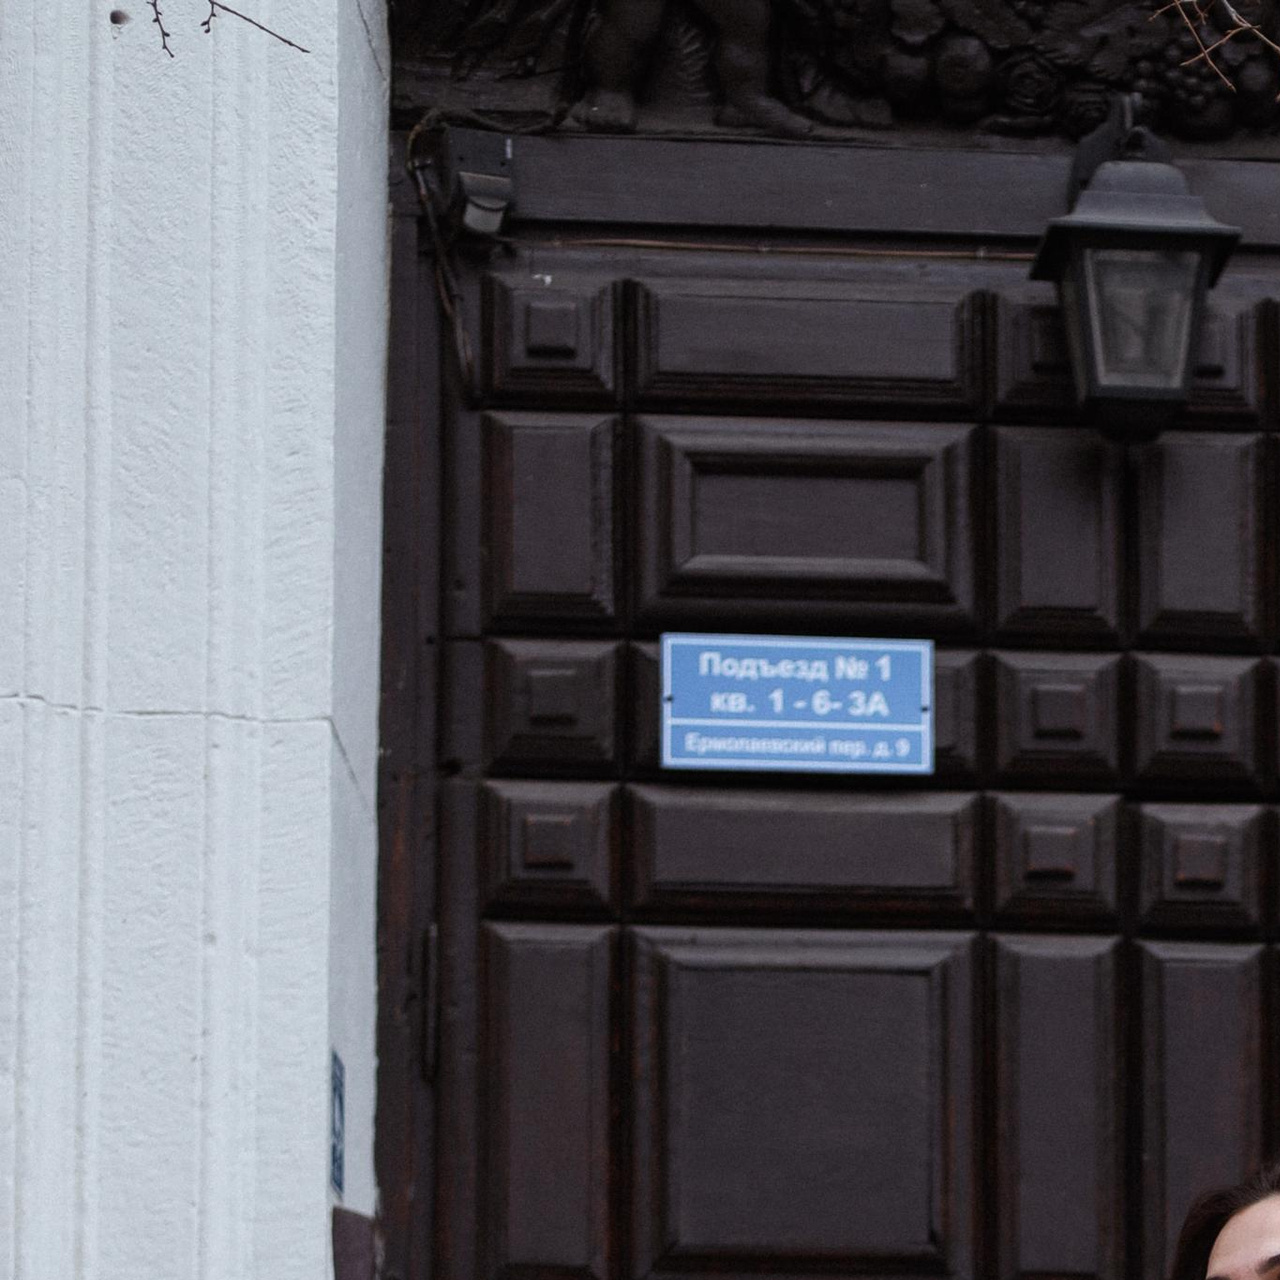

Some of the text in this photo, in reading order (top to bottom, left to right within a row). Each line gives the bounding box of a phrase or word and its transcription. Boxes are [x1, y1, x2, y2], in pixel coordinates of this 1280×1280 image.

[700, 652, 891, 682] Подъезд № 1
[710, 692, 755, 713] кв.
[769, 688, 784, 713] 1
[684, 732, 911, 759] Ермолаевский пер. д. 9
